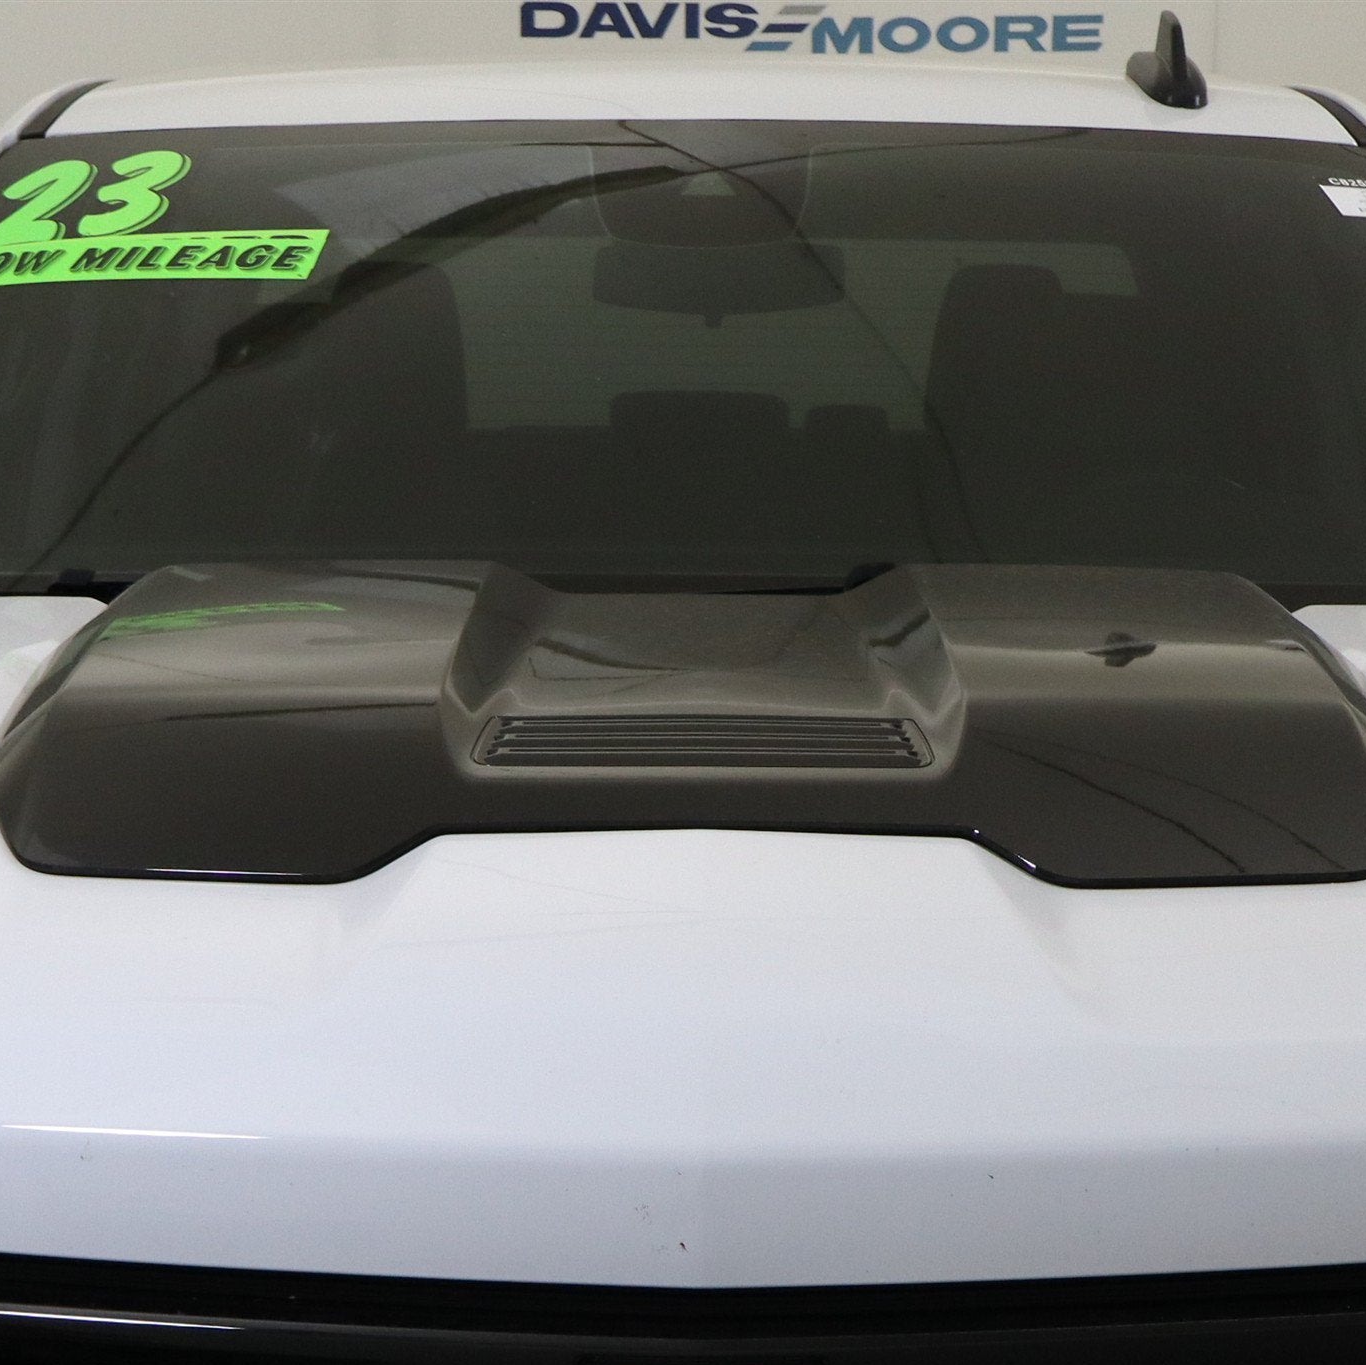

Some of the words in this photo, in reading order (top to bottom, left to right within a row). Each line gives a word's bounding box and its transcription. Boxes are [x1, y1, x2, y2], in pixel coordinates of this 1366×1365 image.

[520, 2, 760, 39] DAVIS
[810, 15, 1104, 54] MOORE
[69, 244, 313, 274] MILEAGE
